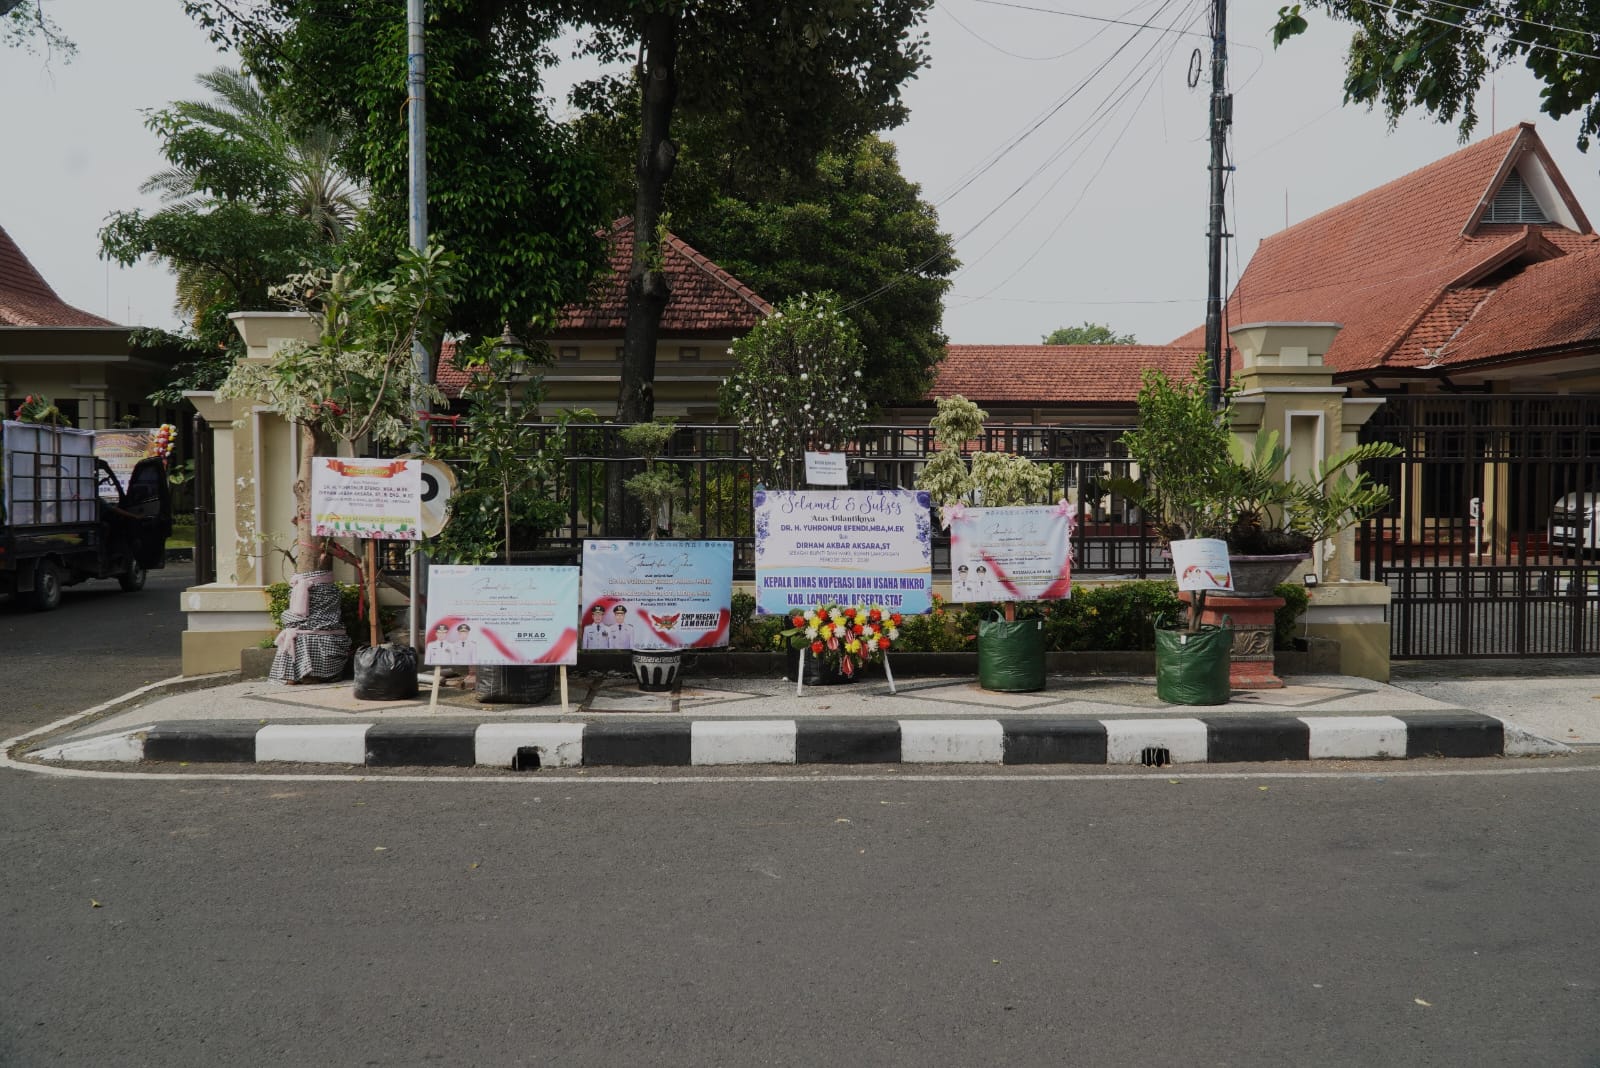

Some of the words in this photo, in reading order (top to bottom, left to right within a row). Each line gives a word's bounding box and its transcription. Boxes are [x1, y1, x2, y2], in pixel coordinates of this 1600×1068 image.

[781, 495, 840, 514] Selamat
[859, 495, 902, 515] Sukses
[763, 576, 792, 588] KEPALA
[793, 576, 817, 589] DINAS
[818, 577, 855, 589] KOPERASI
[856, 577, 872, 589] DAN
[873, 577, 898, 589] USAHA
[900, 578, 925, 590] MIKRO
[788, 594, 806, 605] KAB.
[852, 594, 884, 606] BESERTA
[885, 595, 903, 606] STAF
